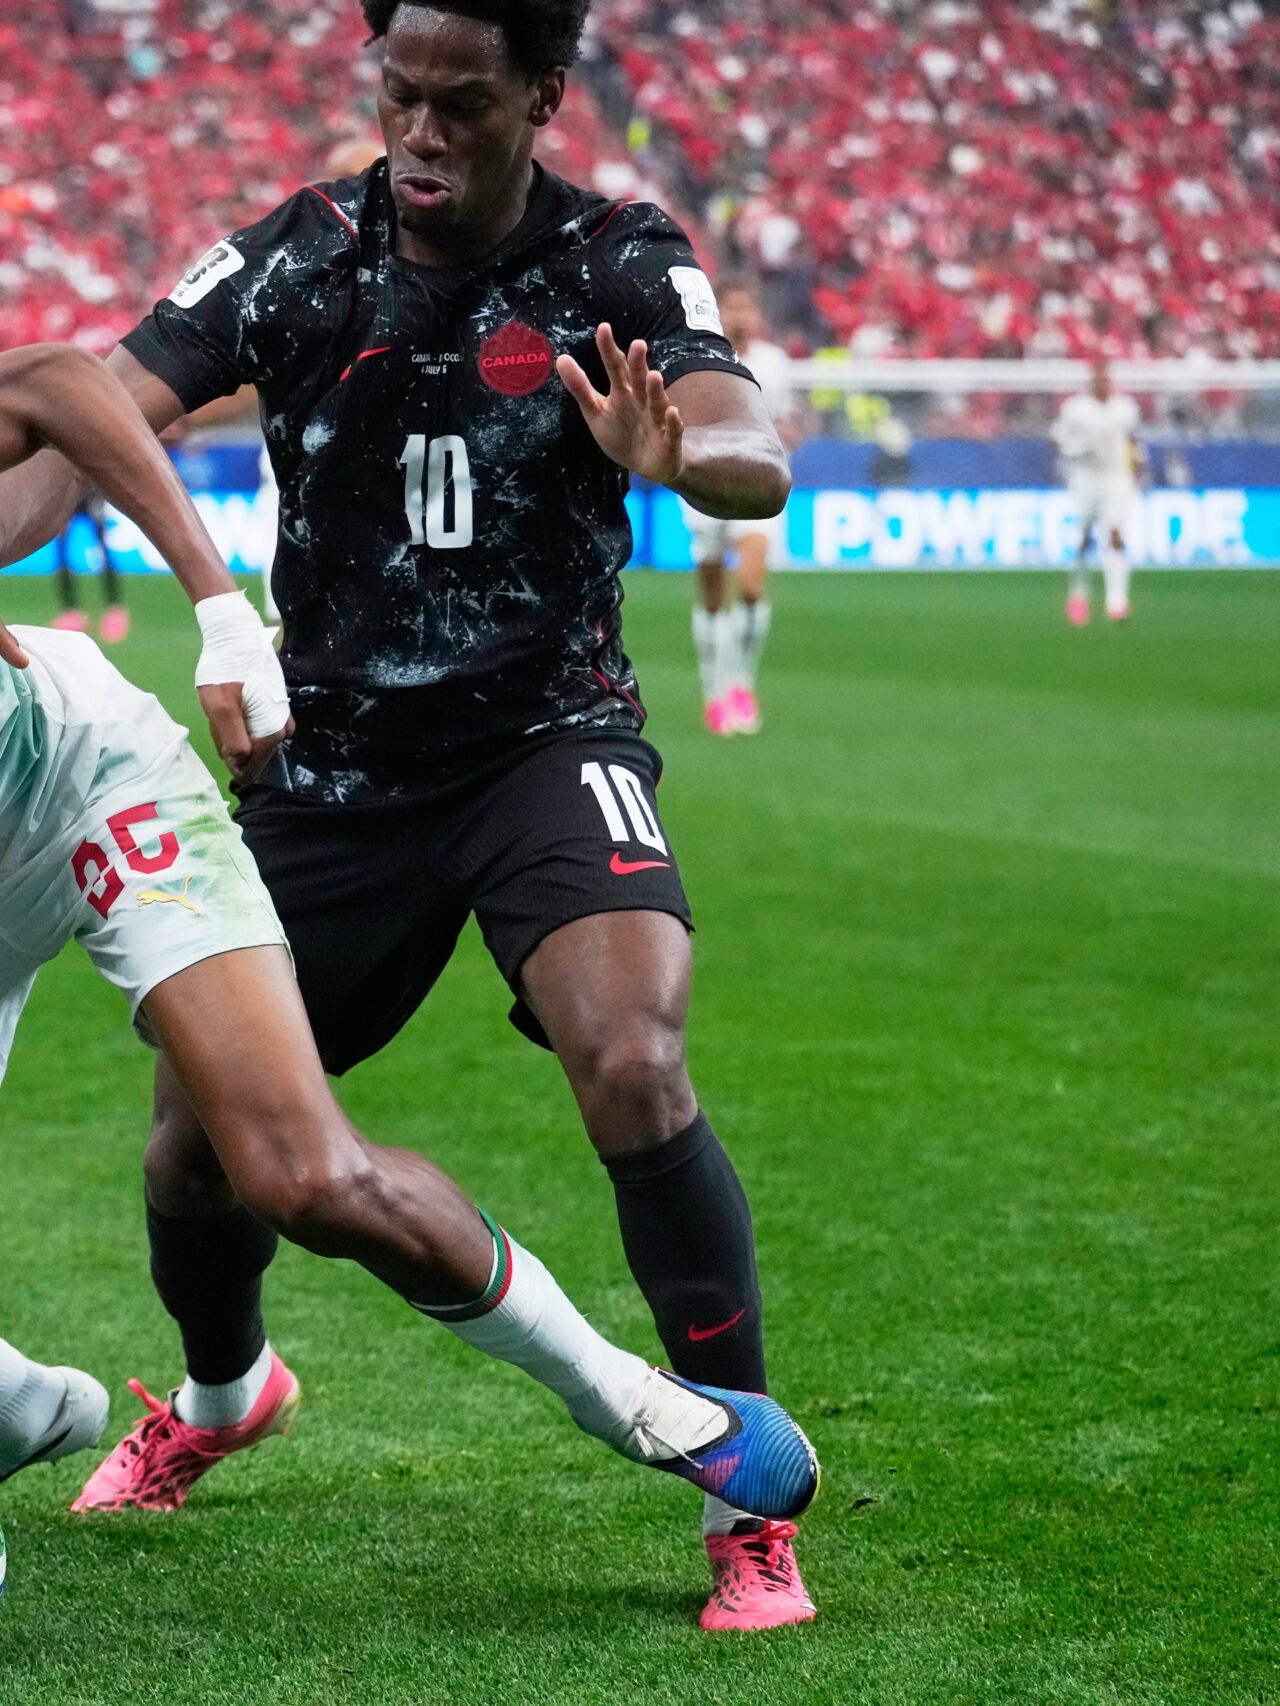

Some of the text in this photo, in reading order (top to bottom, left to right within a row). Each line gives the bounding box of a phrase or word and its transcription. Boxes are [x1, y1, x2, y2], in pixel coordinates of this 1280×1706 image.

[481, 352, 548, 369] CANADA
[399, 433, 473, 549] 10
[580, 761, 669, 857] 10
